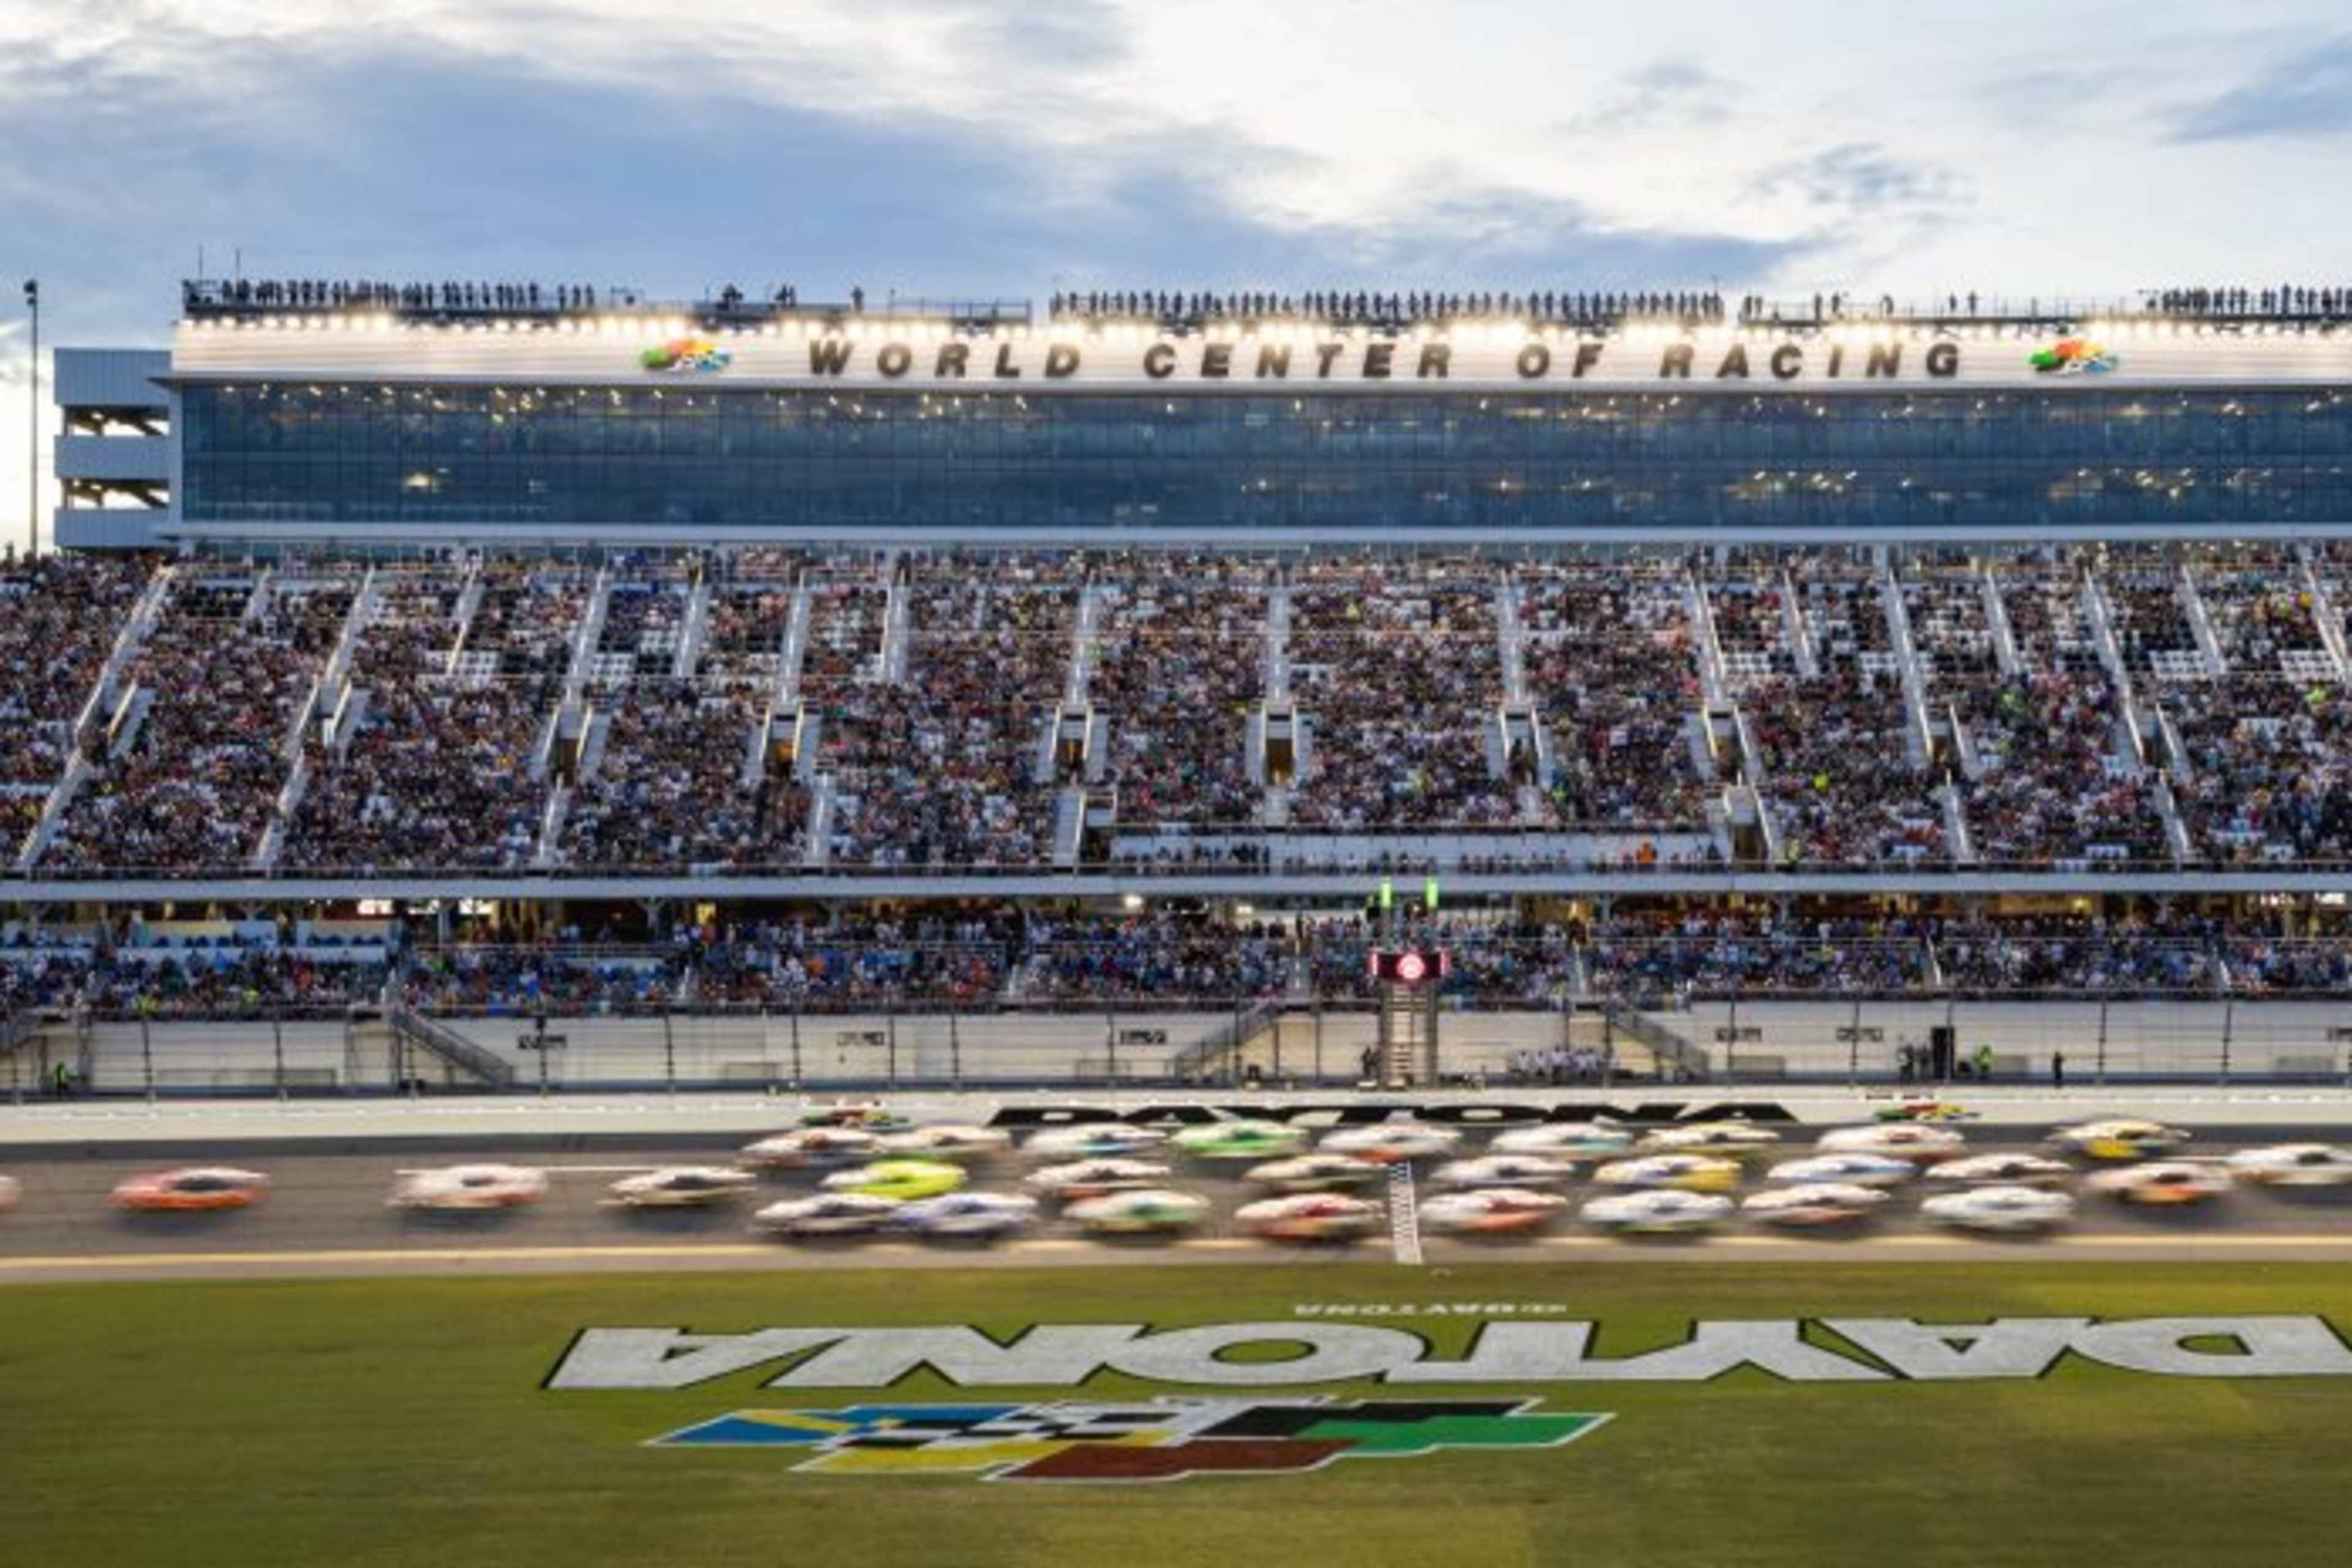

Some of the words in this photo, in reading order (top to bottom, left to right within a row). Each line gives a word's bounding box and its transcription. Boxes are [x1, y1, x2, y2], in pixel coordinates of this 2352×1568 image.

[809, 341, 1080, 379] WORLD
[1143, 344, 1452, 378] CENTER
[1517, 344, 1604, 378] OF
[1659, 344, 1958, 378] RACING
[987, 1104, 1800, 1125] DAYTONA
[540, 1316, 2352, 1389] DAYTONA
